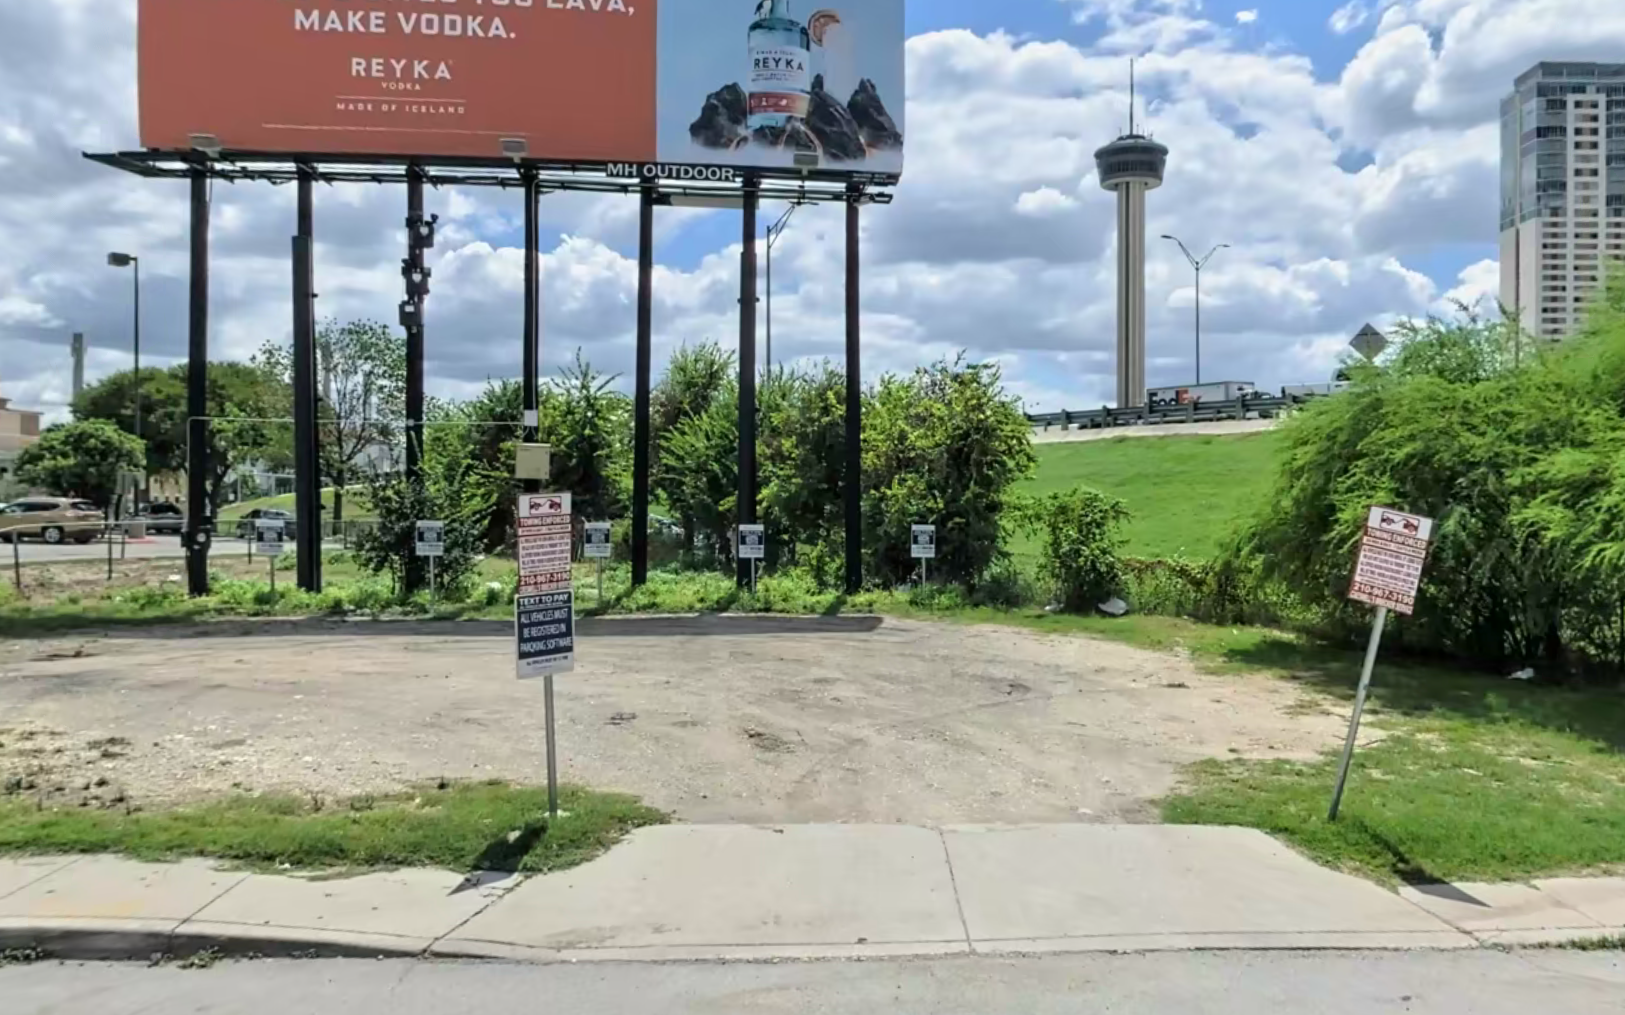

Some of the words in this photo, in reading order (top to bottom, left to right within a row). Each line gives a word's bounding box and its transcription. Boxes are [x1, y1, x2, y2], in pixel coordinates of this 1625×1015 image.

[294, 9, 387, 33] MAKE
[397, 12, 516, 39] VODKA.
[351, 57, 452, 80] REYKA
[753, 57, 805, 72] REYKA
[381, 81, 421, 91] VODKA
[336, 102, 373, 112] MADE
[381, 103, 397, 112] OF
[405, 104, 465, 114] ICELAND
[606, 162, 637, 176] MH
[643, 164, 734, 181] OUTDOOR
[519, 596, 540, 607] TEXT
[541, 595, 553, 603] TO
[553, 593, 569, 603] PAY
